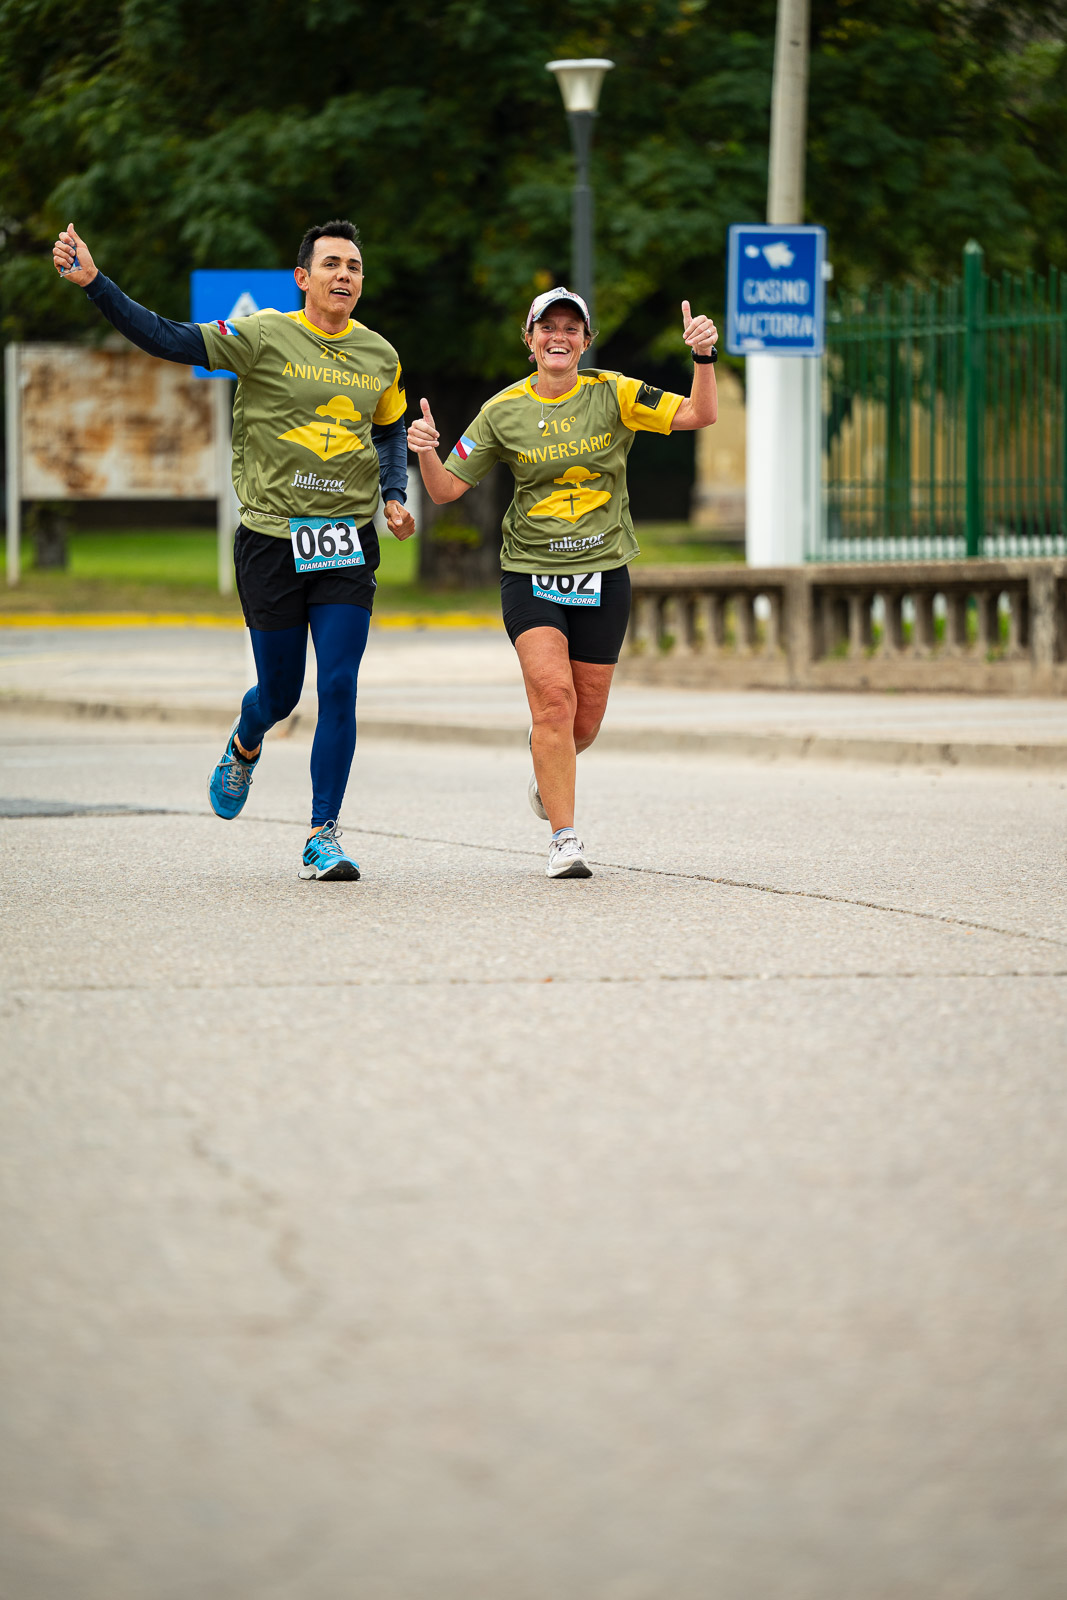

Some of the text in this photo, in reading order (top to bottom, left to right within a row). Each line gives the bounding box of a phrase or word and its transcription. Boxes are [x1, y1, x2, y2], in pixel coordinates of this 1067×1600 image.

[743, 280, 811, 305] CASINO
[735, 313, 817, 338] VICTORIA
[281, 361, 381, 392] ANIVERSARIO
[517, 432, 612, 464] ANIVERSARIO
[291, 469, 346, 489] julicroc
[296, 522, 354, 561] 063
[299, 557, 361, 571] DIAMANTE CORRE
[536, 590, 597, 605] DIAMANTE CORRE
